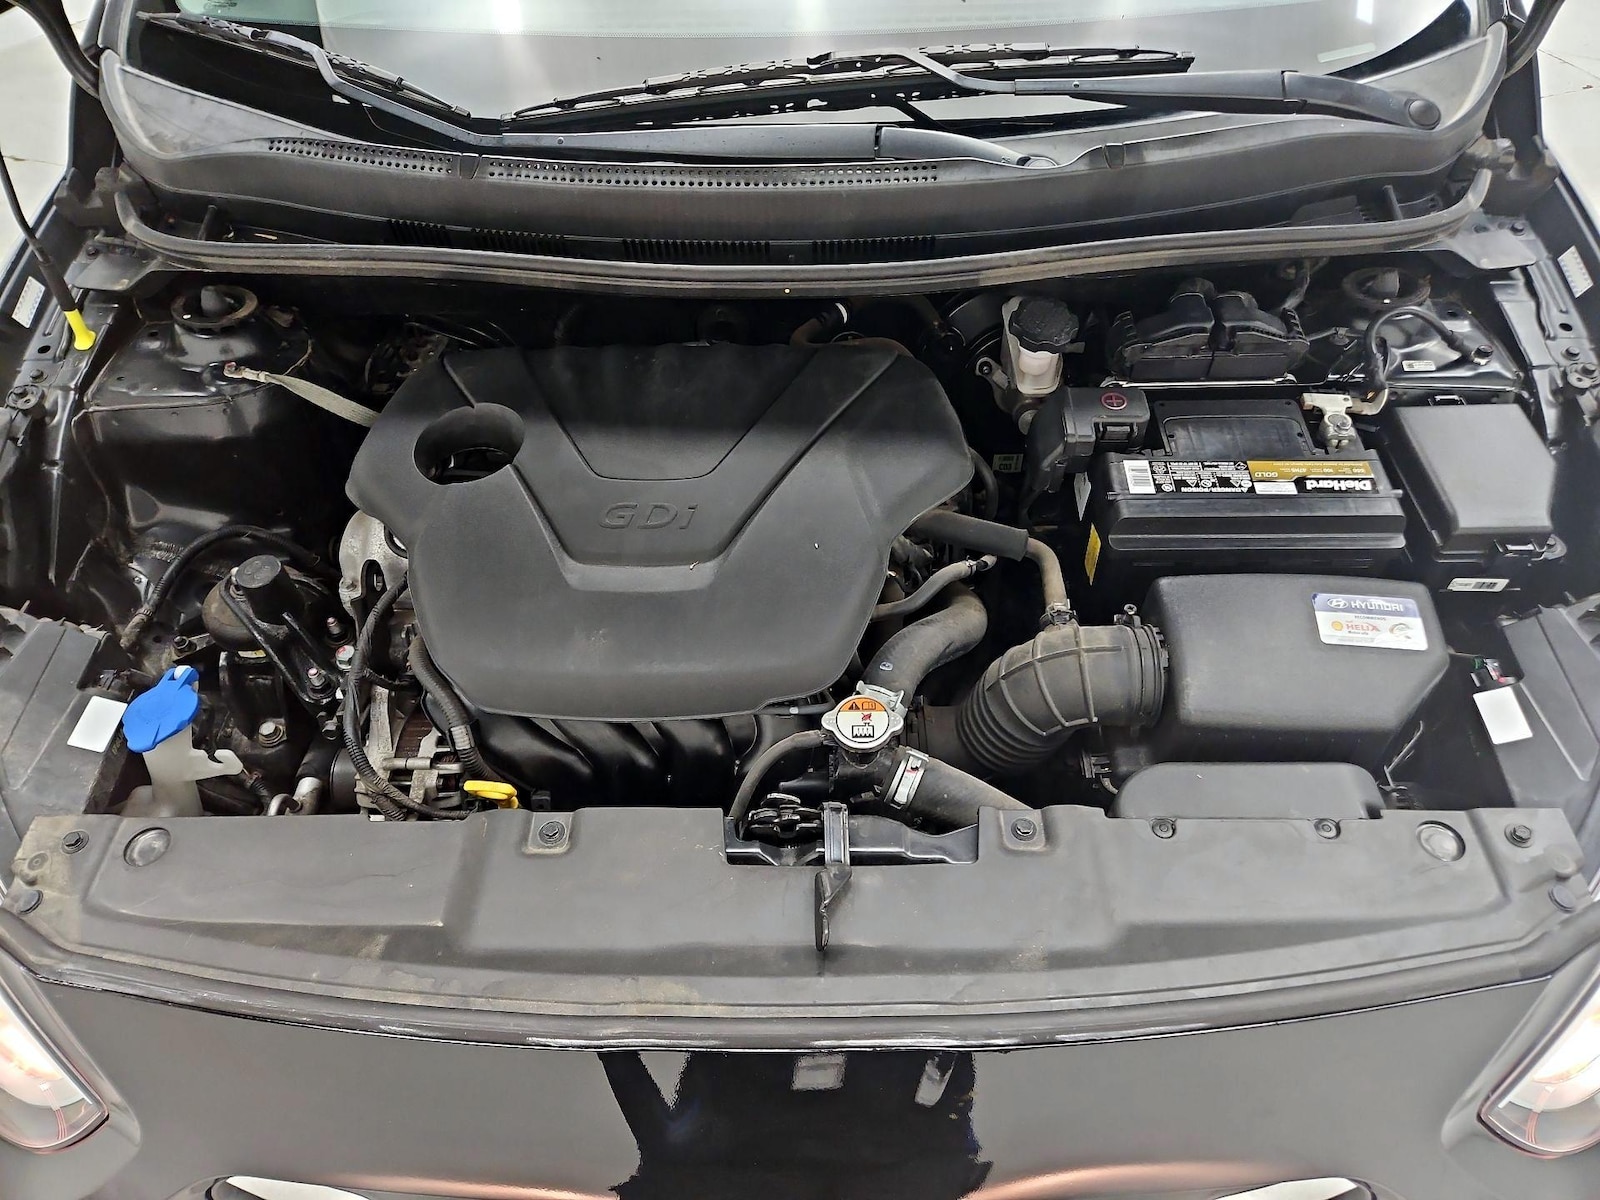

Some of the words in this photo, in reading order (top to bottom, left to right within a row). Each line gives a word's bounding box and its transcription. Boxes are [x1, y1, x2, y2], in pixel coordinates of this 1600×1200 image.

[1305, 479, 1372, 491] DieHard
[599, 501, 699, 530] GDi
[1351, 599, 1404, 612] HYUNDAI
[1346, 622, 1381, 632] HELIX
